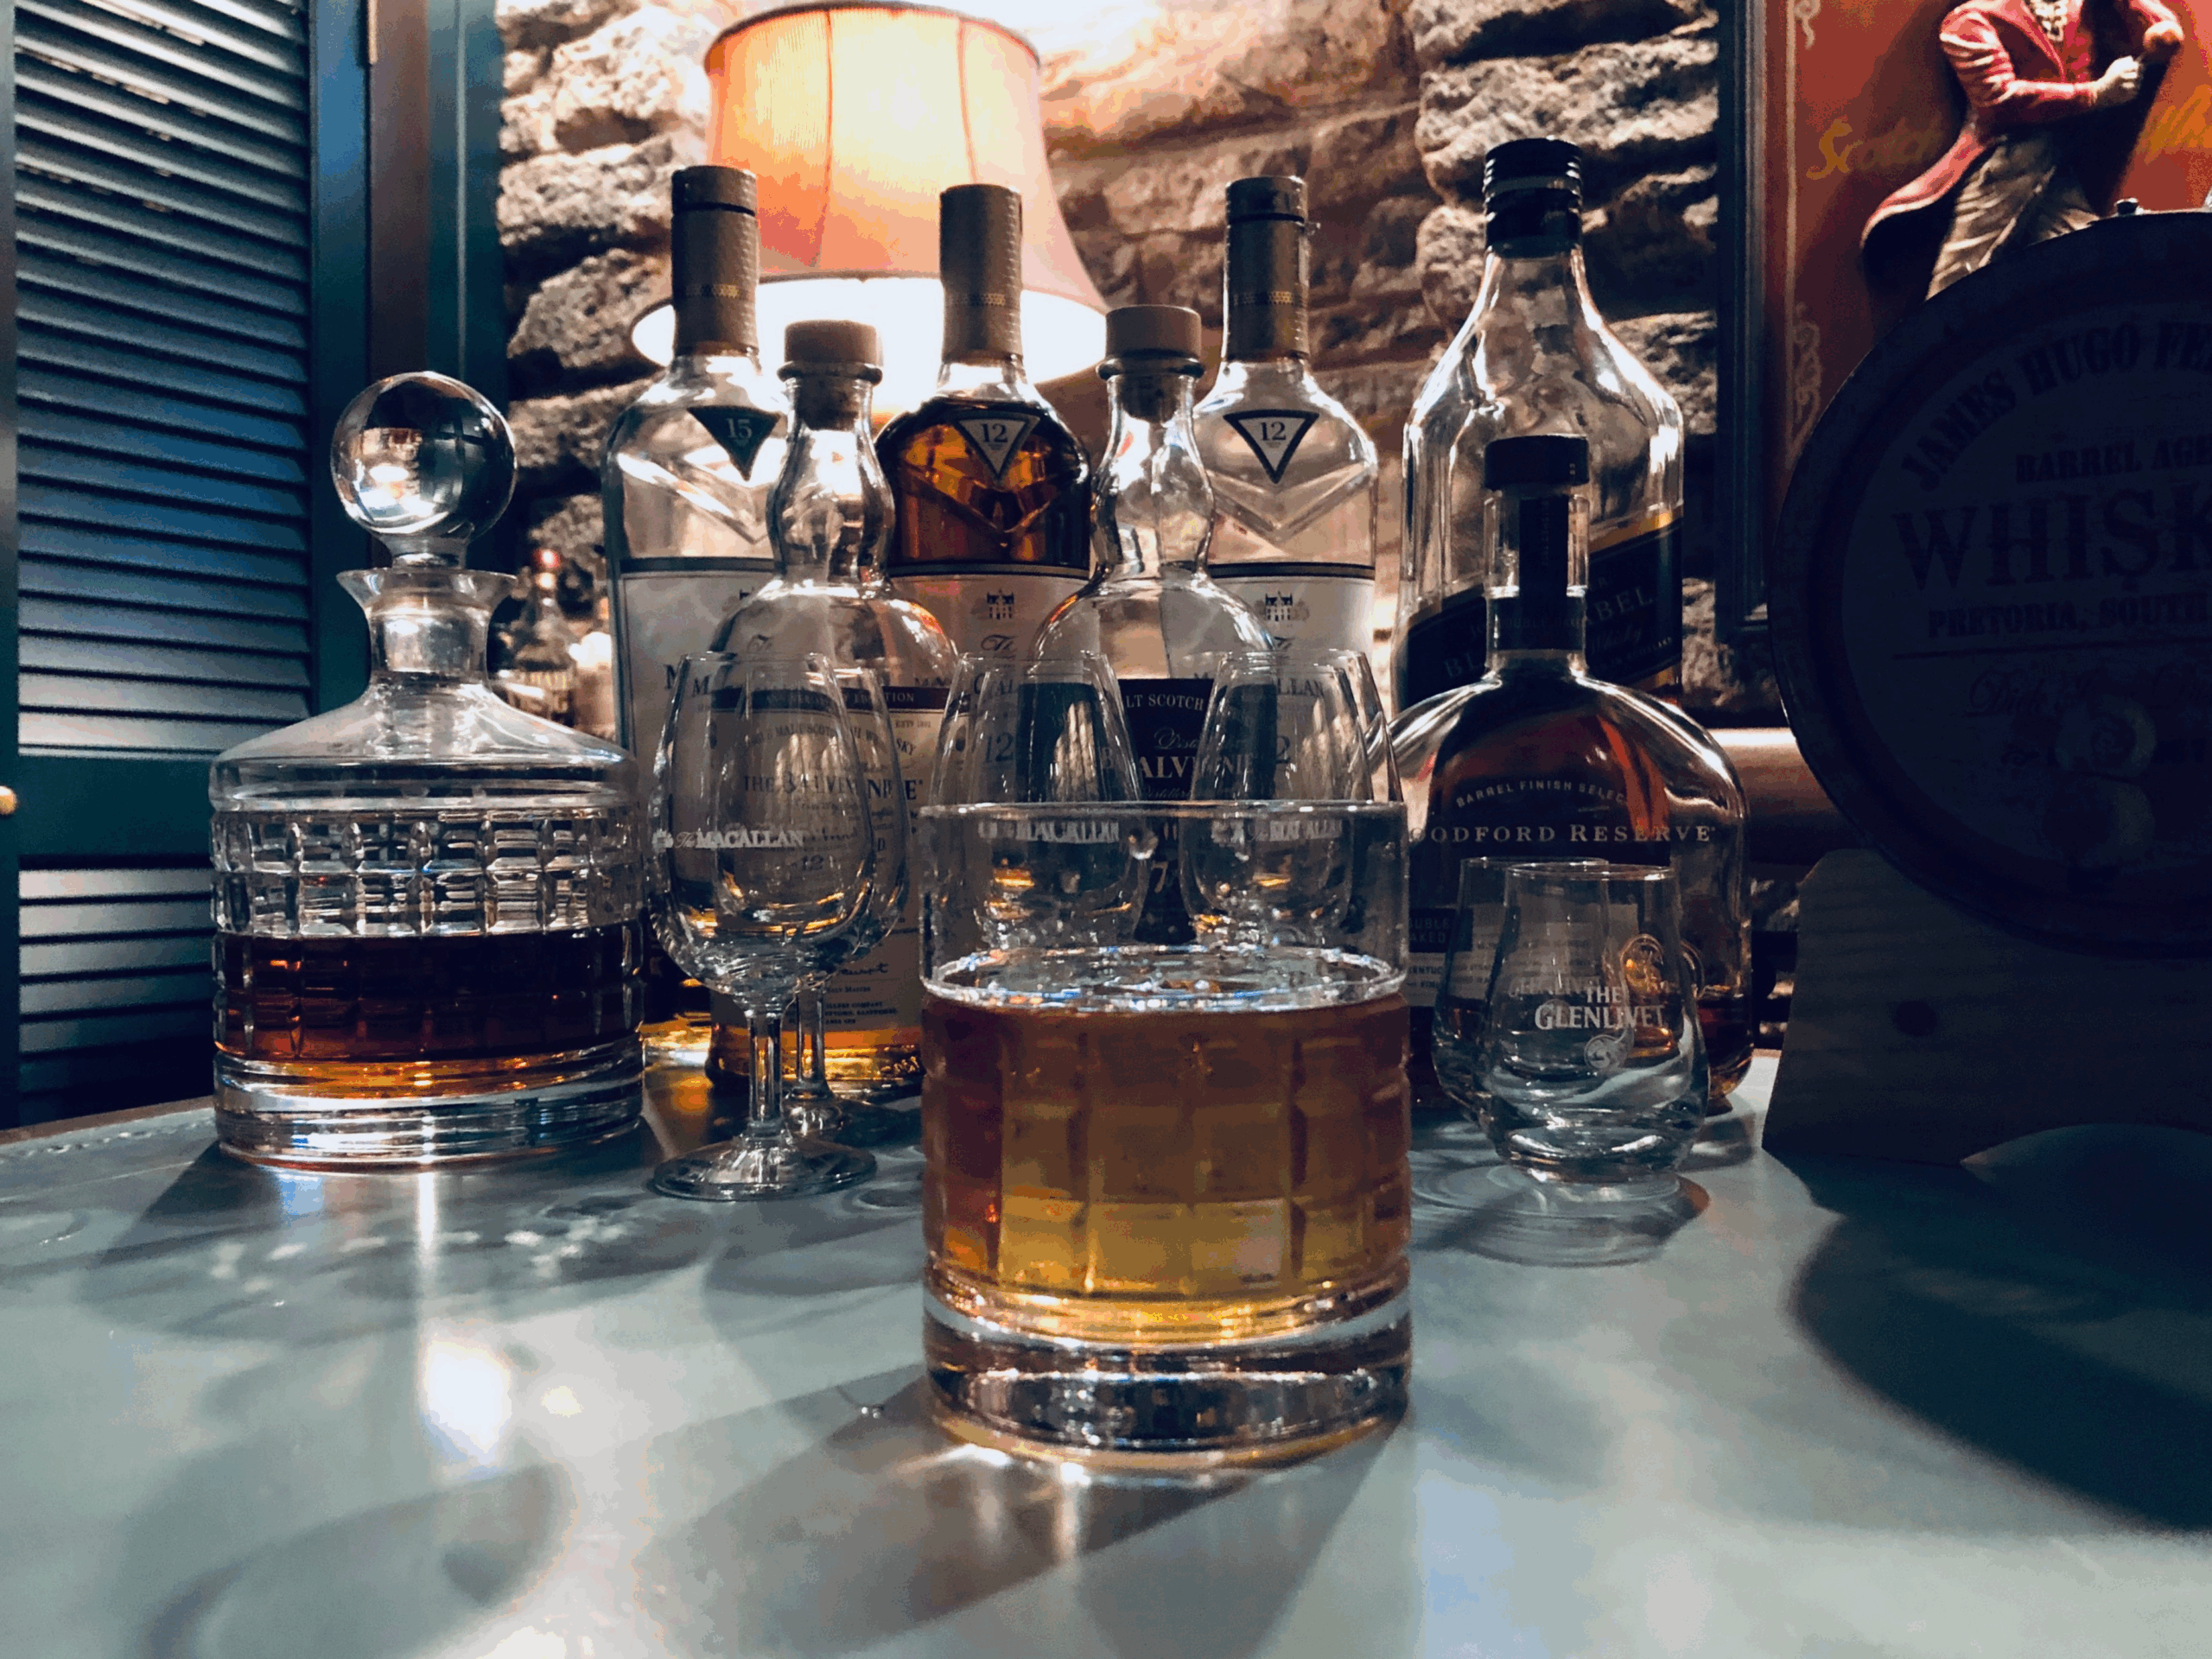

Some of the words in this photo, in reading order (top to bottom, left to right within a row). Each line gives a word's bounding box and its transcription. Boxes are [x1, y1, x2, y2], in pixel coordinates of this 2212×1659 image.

[1901, 366, 2018, 491] JAMES
[2015, 322, 2141, 397] HUGO
[2154, 321, 2212, 375] FE
[726, 417, 753, 439] 15
[982, 423, 1008, 443] 12
[1261, 421, 1287, 442] 12
[2015, 441, 2142, 485] BARREL
[1891, 484, 2212, 592] WHISK
[2098, 592, 2209, 628] SOUTH
[1147, 694, 1204, 711] SCOTCH
[1456, 782, 1512, 809] BARREL
[1519, 779, 1573, 791] FINISH
[1578, 782, 1628, 804] SELEC
[696, 830, 804, 849] MACALLAN
[1409, 826, 1555, 843] OODFORD
[1569, 823, 1711, 843] RESERVE
[1586, 985, 1622, 1005] THE
[1535, 1004, 1666, 1031] GLENLIVET
